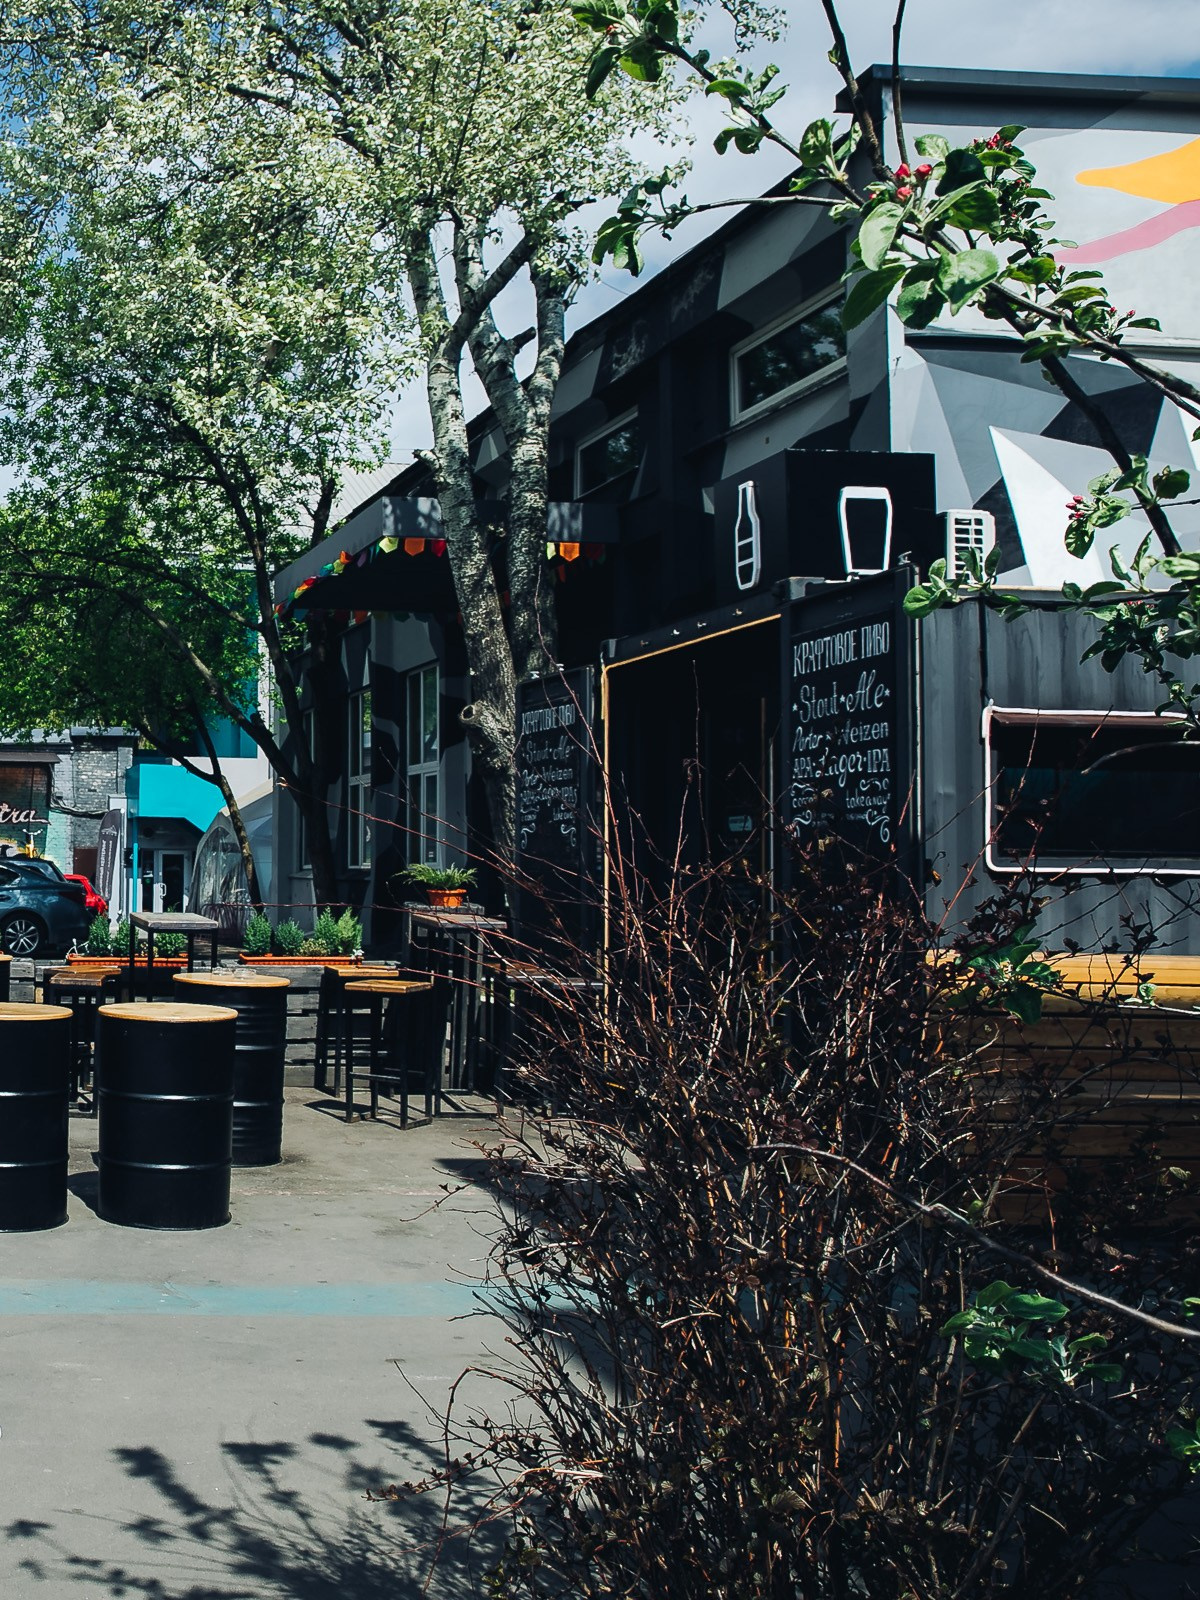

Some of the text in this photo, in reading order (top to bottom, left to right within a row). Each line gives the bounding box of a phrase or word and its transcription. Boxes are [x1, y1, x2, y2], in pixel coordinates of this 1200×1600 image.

[793, 622, 890, 677] КРАФТОВОЕ ПИВО
[800, 682, 839, 723] Stout
